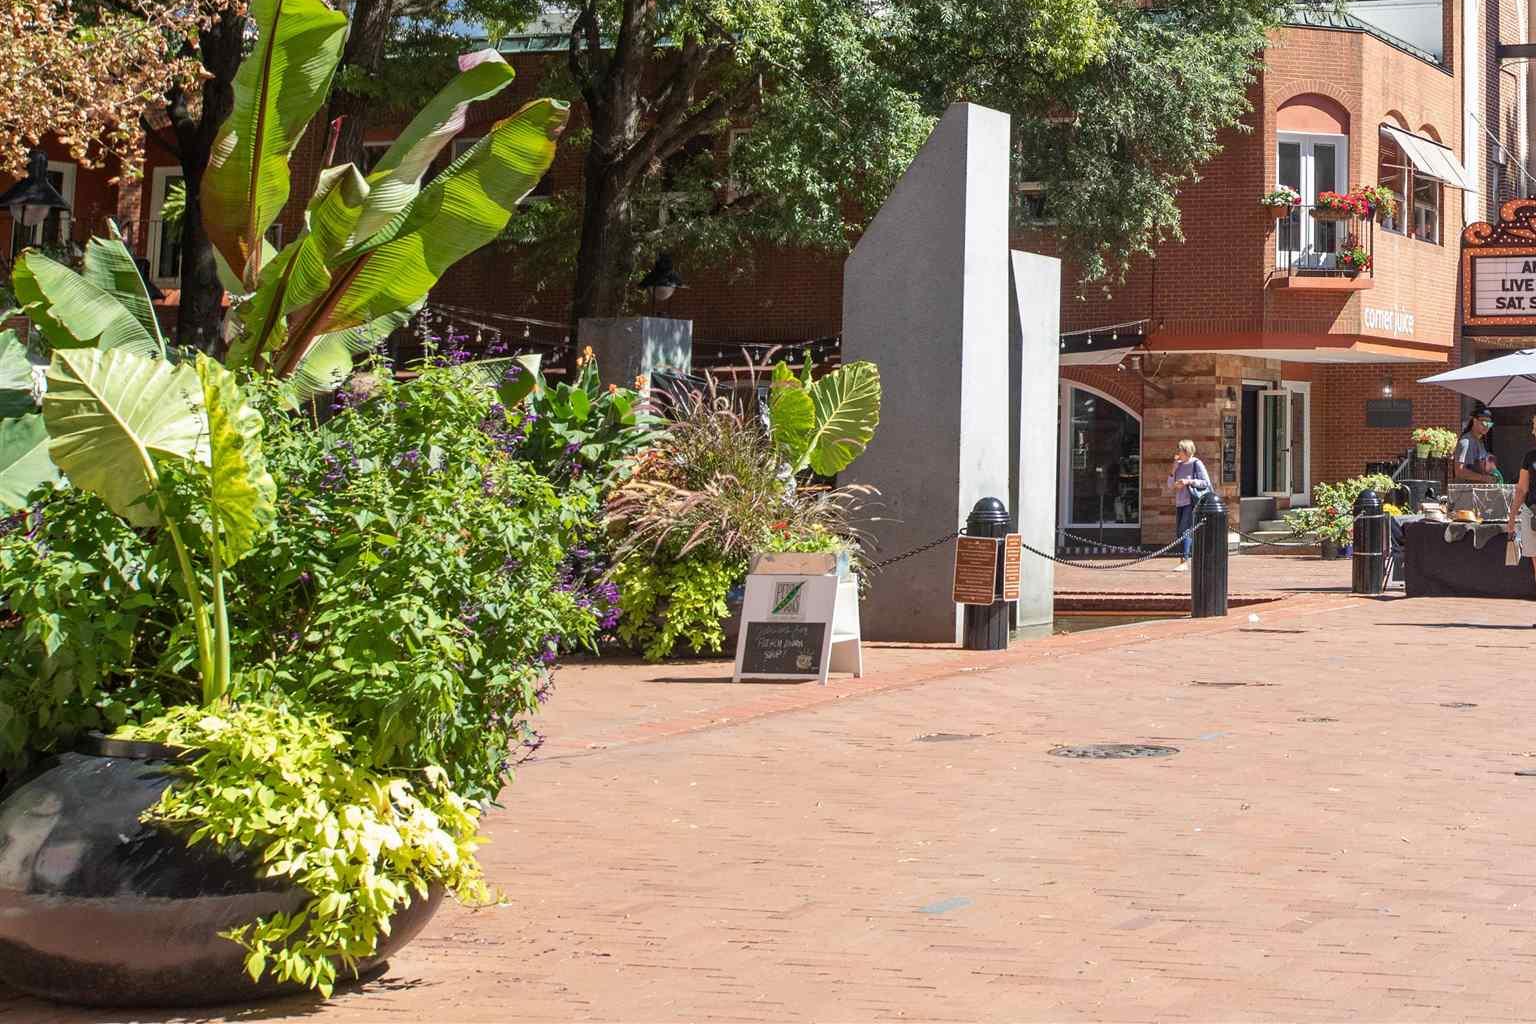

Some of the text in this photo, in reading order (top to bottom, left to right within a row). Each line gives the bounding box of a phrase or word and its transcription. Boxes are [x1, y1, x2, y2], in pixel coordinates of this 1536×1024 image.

[1501, 279, 1534, 292] LIVE
[1495, 297, 1526, 310] SAT.
[1363, 304, 1415, 336] corner juice
